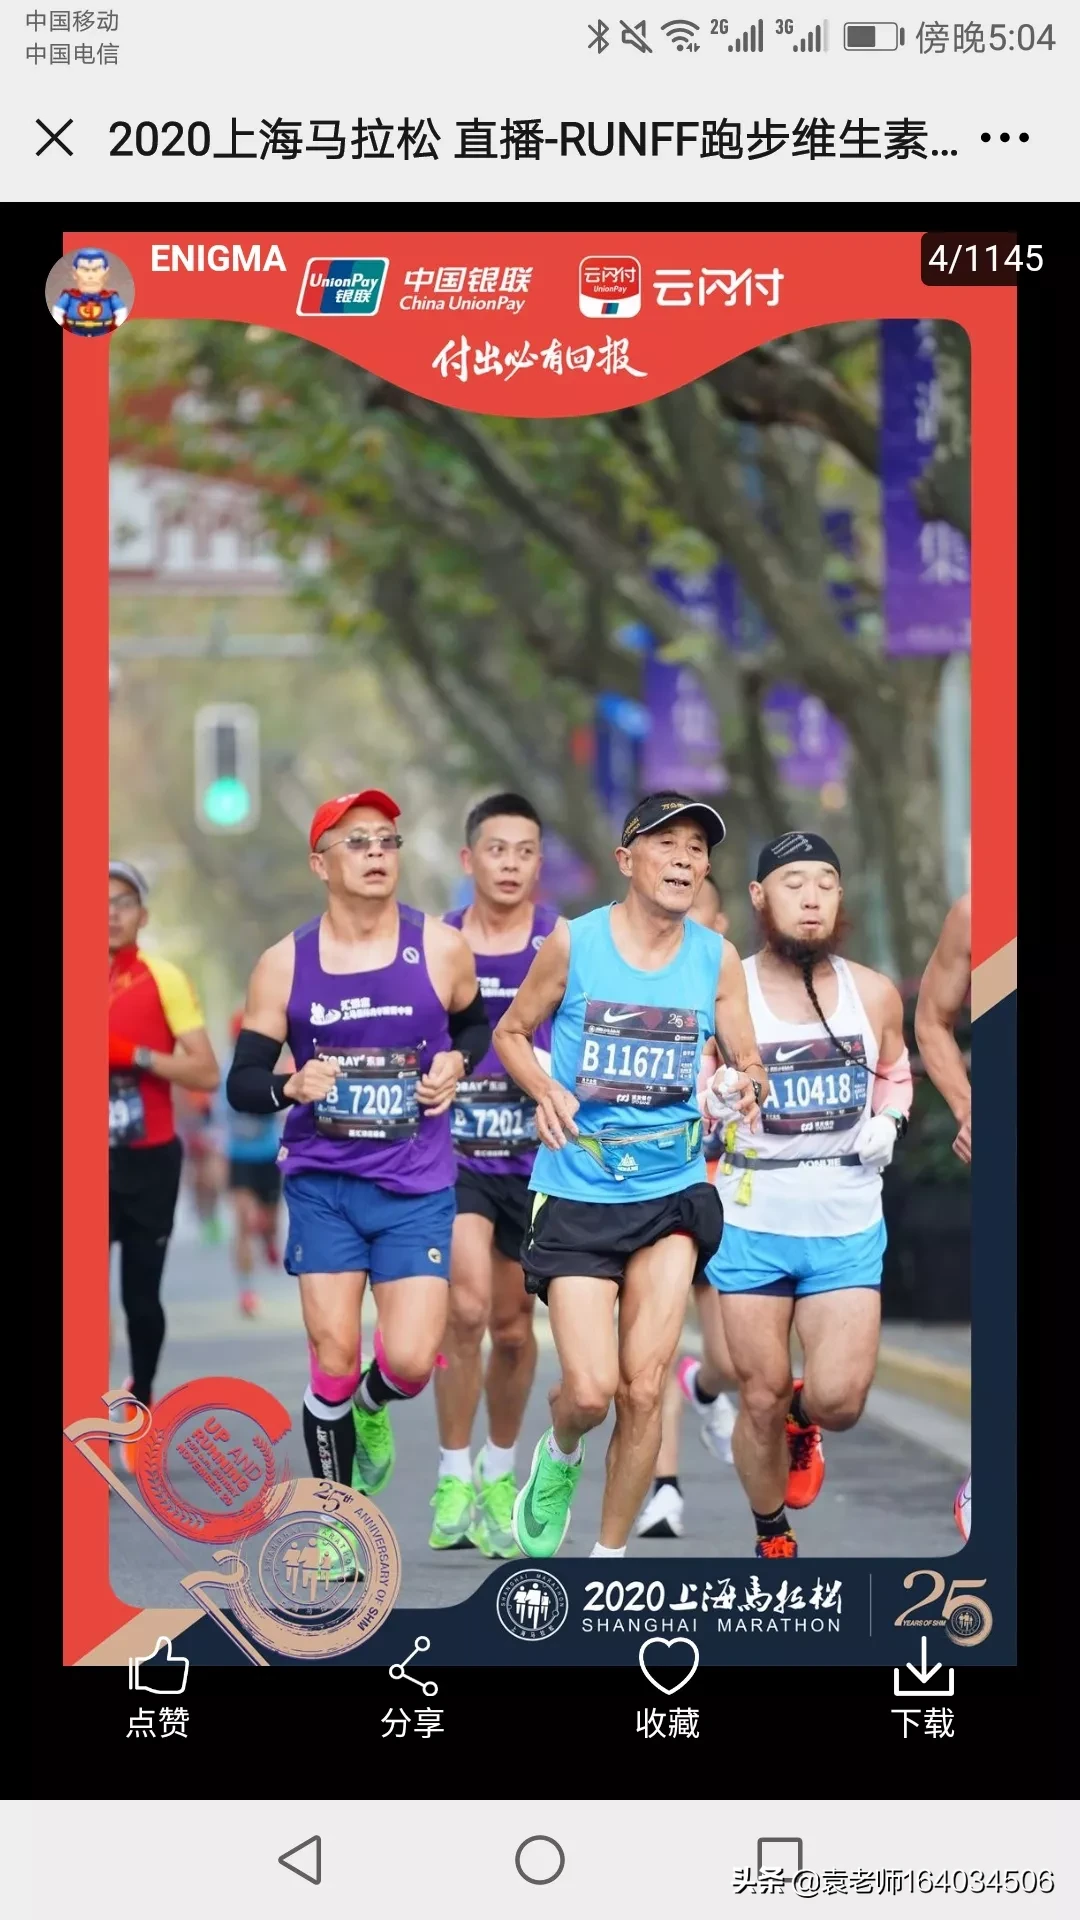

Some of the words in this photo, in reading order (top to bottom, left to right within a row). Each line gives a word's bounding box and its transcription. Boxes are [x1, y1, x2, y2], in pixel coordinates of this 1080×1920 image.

[26, 9, 119, 33] 中国移动
[710, 18, 729, 35] 2G
[775, 18, 794, 35] 3G
[915, 20, 1057, 55] 傍晚5:04
[26, 42, 120, 66] 中国电信
[108, 116, 442, 161] 2020上海马拉松
[151, 244, 287, 272] ENIGMA
[928, 244, 1043, 274] 4/1145
[349, 1083, 403, 1115] 7202
[472, 1107, 525, 1138] 7201
[125, 1706, 190, 1739] 点赞
[380, 1706, 445, 1739] 分享
[636, 1706, 700, 1739] 收藏
[890, 1706, 955, 1739] 下载
